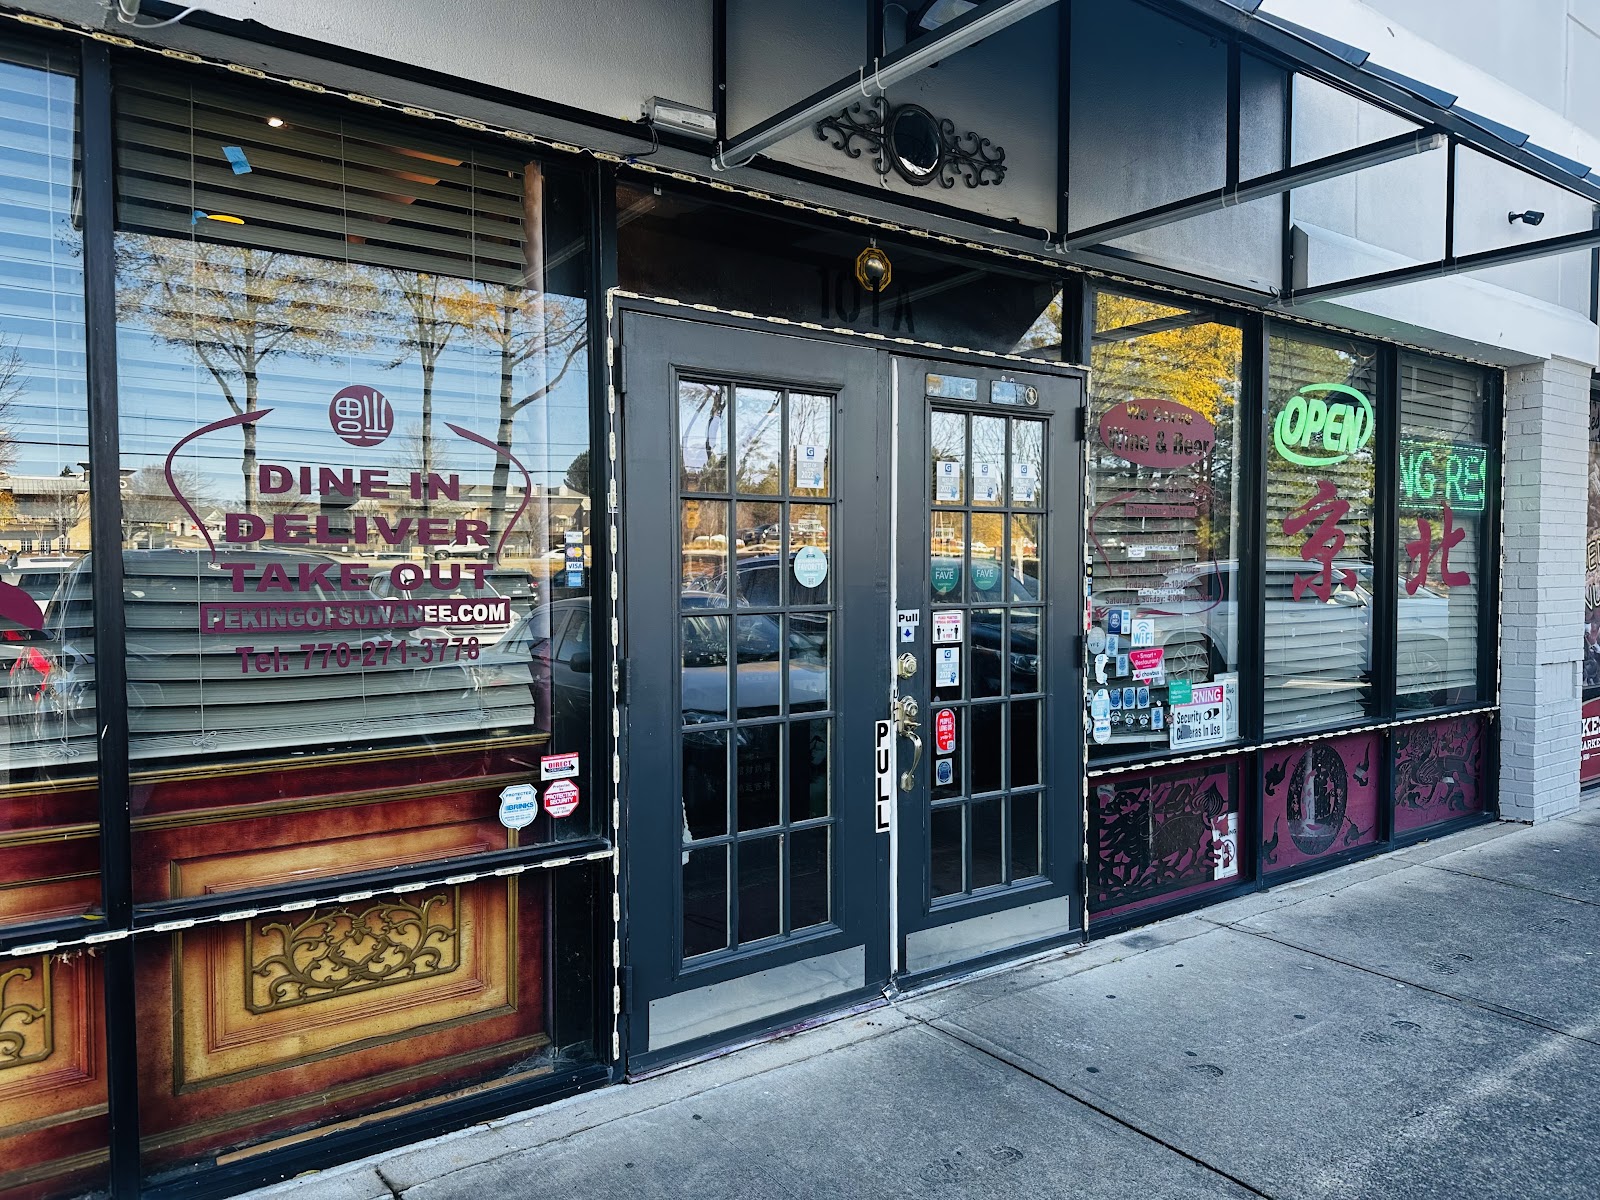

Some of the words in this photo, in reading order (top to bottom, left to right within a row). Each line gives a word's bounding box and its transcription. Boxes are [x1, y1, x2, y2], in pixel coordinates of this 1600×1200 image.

[1126, 402, 1149, 421] We
[1153, 406, 1193, 426] Serve
[1281, 396, 1365, 454] OPEN
[1107, 425, 1149, 452] Wine
[1155, 431, 1168, 454] &
[1173, 432, 1209, 456] Beer
[258, 464, 389, 499] DINE
[410, 472, 460, 501] IN
[801, 471, 814, 479] 2022
[1445, 453, 1486, 501] RE
[224, 512, 491, 546] DELIVER
[1282, 480, 1358, 603] 京
[1405, 500, 1471, 596] 北
[797, 563, 825, 571] FAVORITE
[976, 569, 994, 578] FAVE
[219, 562, 371, 593] TAKE
[390, 562, 495, 591] OUT
[935, 571, 954, 580] FAVE
[1105, 596, 1133, 605] Saturday
[207, 602, 507, 630] PEKINGOFSUWANEE.COM
[898, 613, 919, 623] Pull
[1133, 632, 1153, 645] WiFi
[236, 645, 290, 674] Tel:
[299, 636, 480, 671] 770-271-3778
[1135, 658, 1159, 666] Restaurant
[1177, 710, 1202, 727] Security
[1177, 726, 1202, 740] Caeras
[1203, 724, 1209, 737] In
[1210, 724, 1221, 736] Use
[548, 760, 572, 769] DIRECT
[877, 722, 889, 830] PULL
[546, 790, 576, 800] PROTECTION
[550, 797, 574, 805] SECURITY
[505, 802, 534, 811] BRINKS
